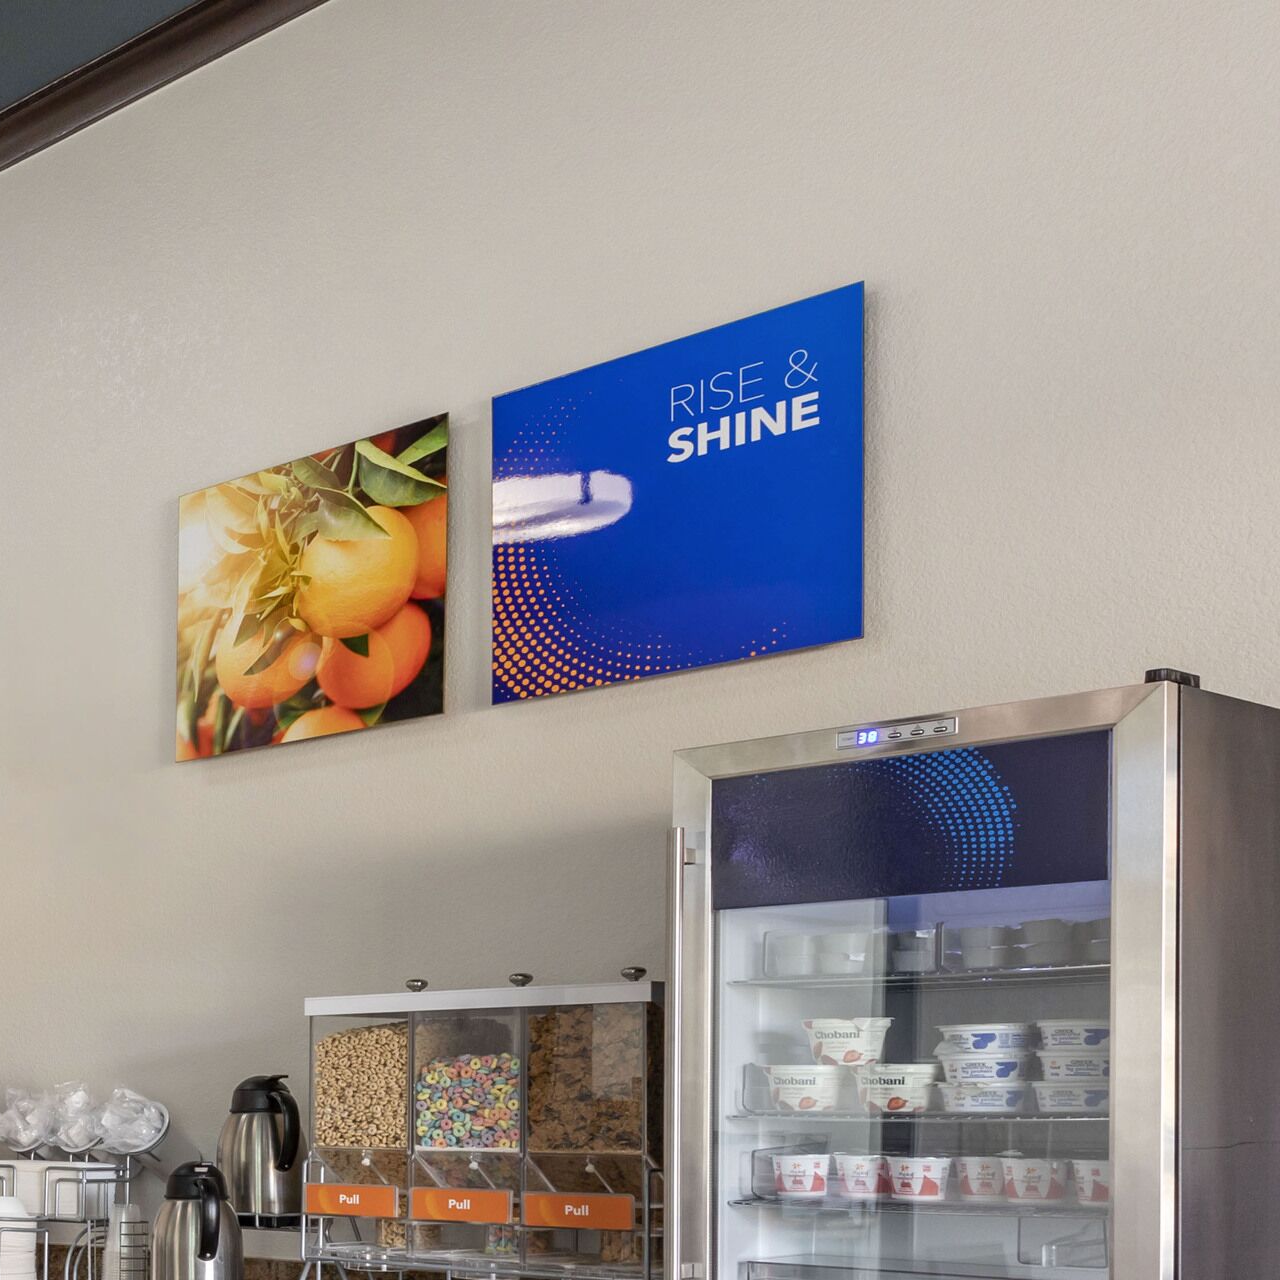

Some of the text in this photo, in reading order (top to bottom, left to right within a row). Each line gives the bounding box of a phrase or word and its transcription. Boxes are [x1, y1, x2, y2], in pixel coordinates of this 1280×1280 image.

[670, 348, 819, 422] RISE &
[666, 391, 821, 464] SHINE
[814, 1030, 861, 1040] Chobani
[773, 1076, 817, 1086] Chobani
[860, 1076, 906, 1086] Chobani
[338, 1194, 360, 1205] Pull
[448, 1198, 471, 1210] Pull
[564, 1204, 590, 1216] Pull
